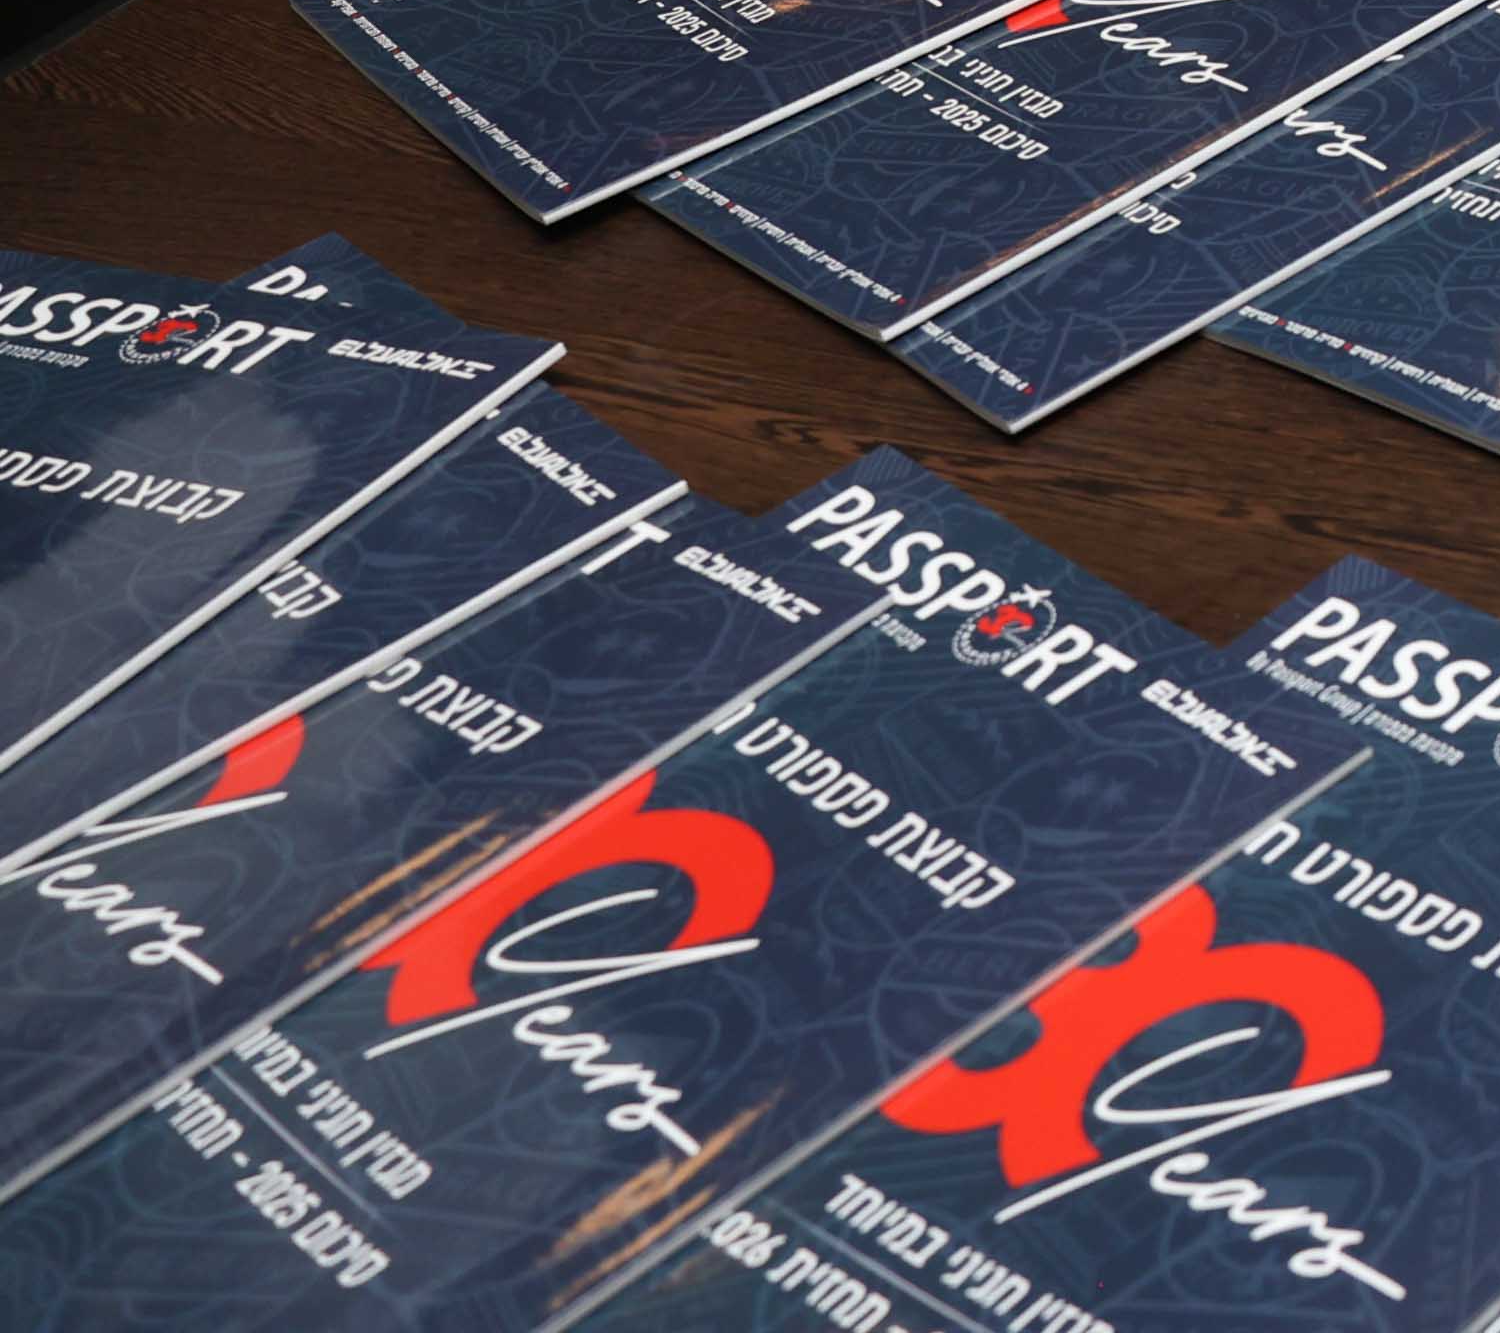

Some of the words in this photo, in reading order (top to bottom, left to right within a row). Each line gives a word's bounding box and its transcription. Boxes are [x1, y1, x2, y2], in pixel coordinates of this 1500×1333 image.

[659, 6, 707, 35] 2025
[692, 27, 747, 62] סיכום
[960, 58, 1013, 93] חגיגי
[999, 82, 1063, 118] מגזין
[932, 97, 994, 133] 2025
[979, 123, 1049, 160] סיכום
[0, 285, 316, 374] ASSPORT
[80, 469, 245, 525] קבוצת
[785, 484, 1138, 706] PASSPORT
[397, 669, 545, 757] קבוצת
[732, 714, 891, 829] פספורט
[866, 810, 1016, 910] קבוצת
[1290, 840, 1484, 953] פספורט
[299, 1078, 374, 1148] חגיגי
[236, 1161, 319, 1228] 2025
[340, 1129, 431, 1198] מגזין
[292, 1208, 389, 1287] סיכום
[711, 1211, 786, 1268] 026
[827, 1173, 948, 1270] במיוחד
[943, 1246, 1029, 1313] חגיגי
